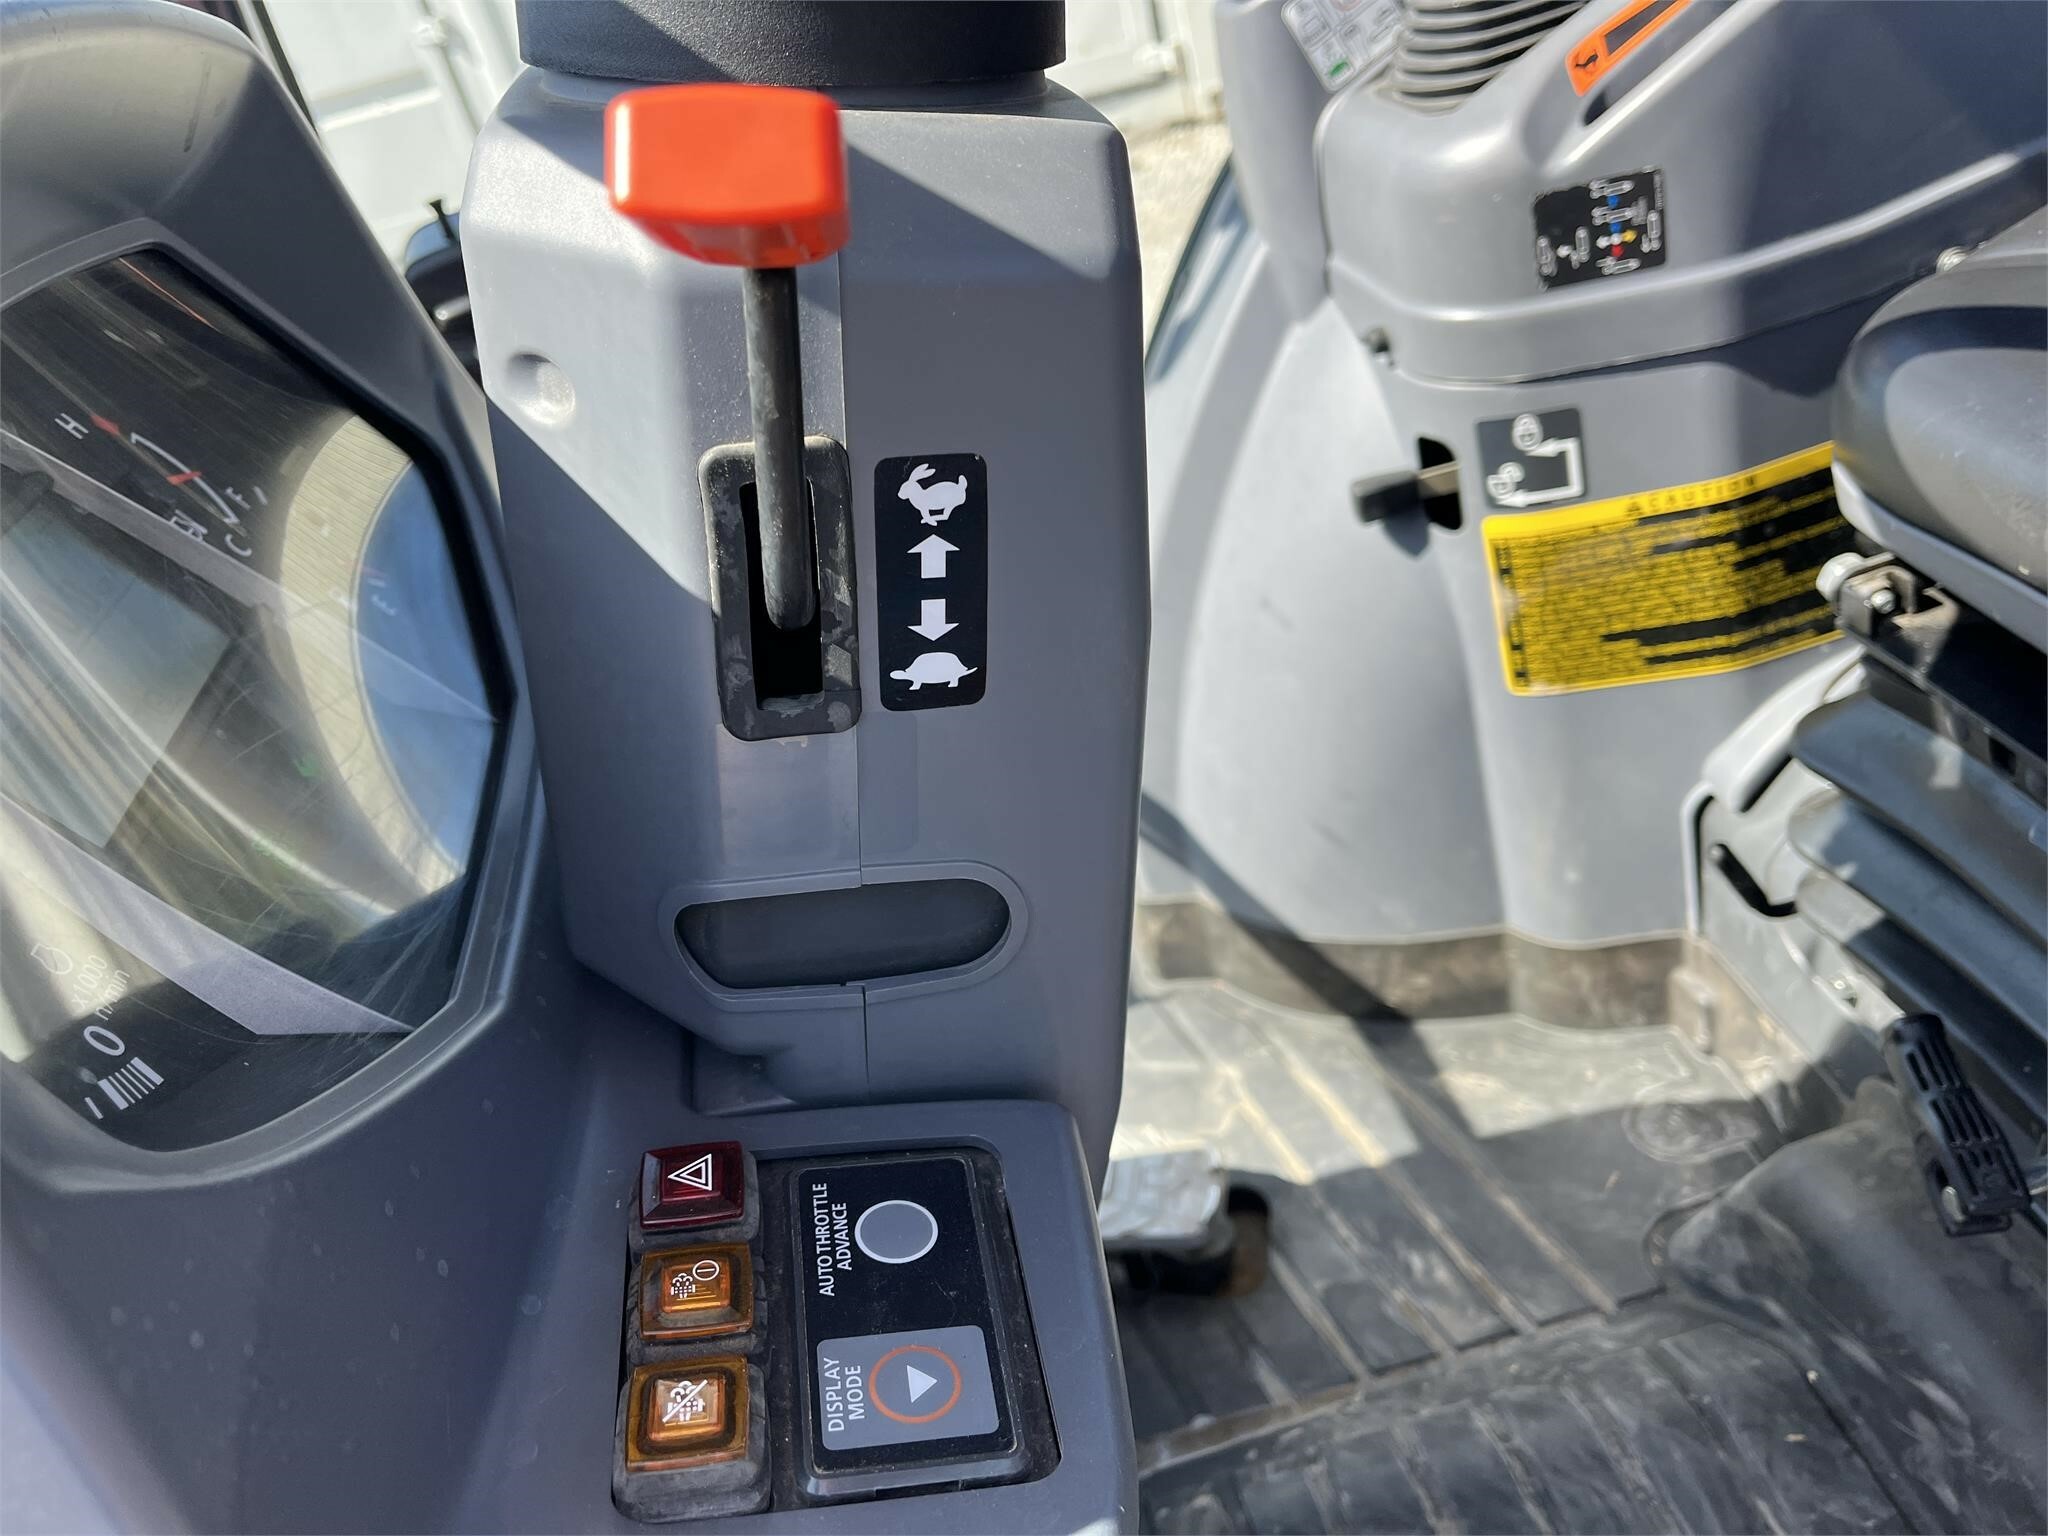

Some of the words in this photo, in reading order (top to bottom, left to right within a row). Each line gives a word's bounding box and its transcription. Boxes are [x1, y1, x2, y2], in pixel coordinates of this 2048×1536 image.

[224, 534, 252, 556] C
[83, 1025, 125, 1056] 0
[812, 1182, 831, 1258] THROTTLE
[832, 1202, 852, 1271] ADVANCE
[817, 1257, 835, 1296] AUTO
[823, 1357, 844, 1432] DISPLAY
[845, 1365, 865, 1420] MODE
